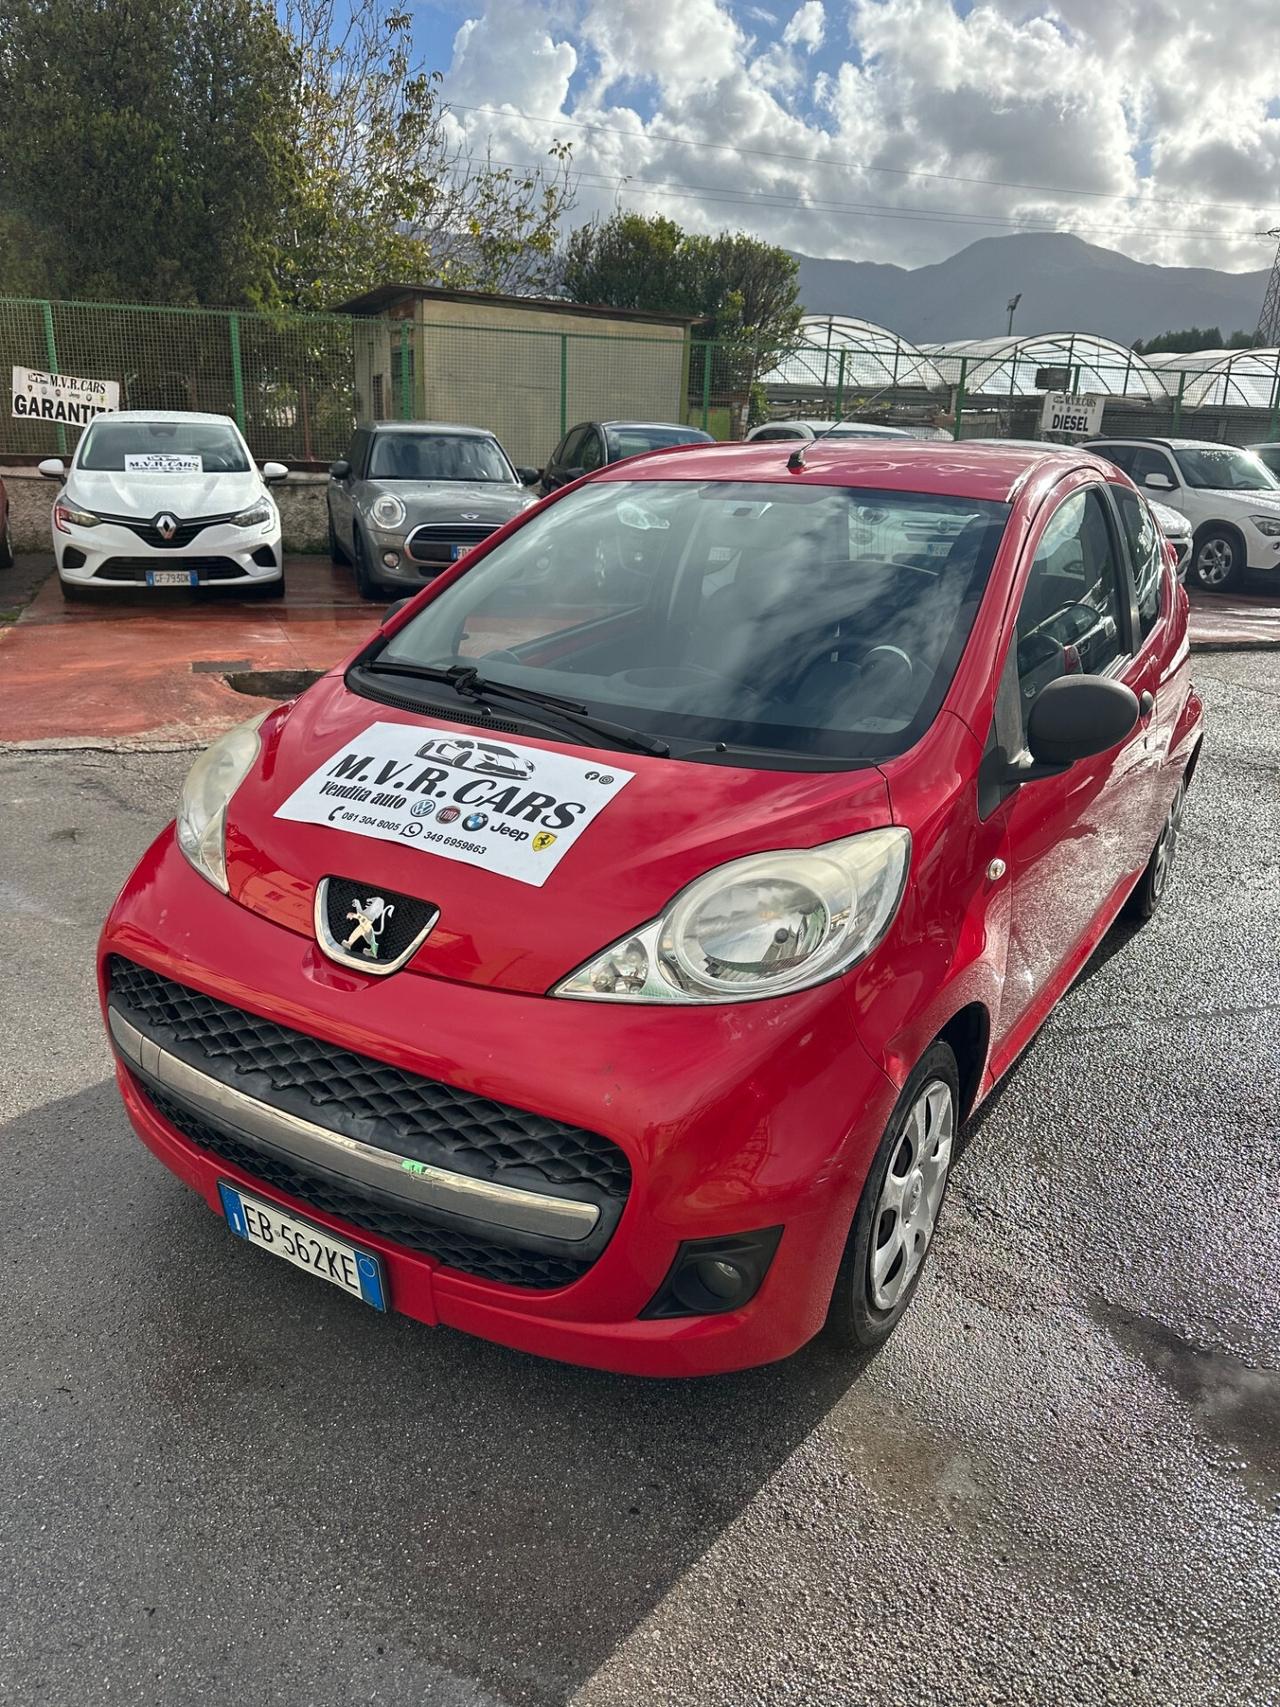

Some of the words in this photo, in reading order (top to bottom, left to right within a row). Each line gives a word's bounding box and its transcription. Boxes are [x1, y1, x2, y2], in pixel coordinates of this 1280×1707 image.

[14, 394, 114, 424] GARANTI
[1051, 414, 1089, 432] DIESEL
[319, 781, 373, 802] Vendita
[369, 792, 407, 809] auto
[341, 812, 360, 823] 081
[359, 815, 378, 827] 304
[376, 819, 402, 832] 8005
[489, 822, 530, 842] Jeep
[423, 831, 444, 843] 349
[443, 836, 488, 855] 6959863
